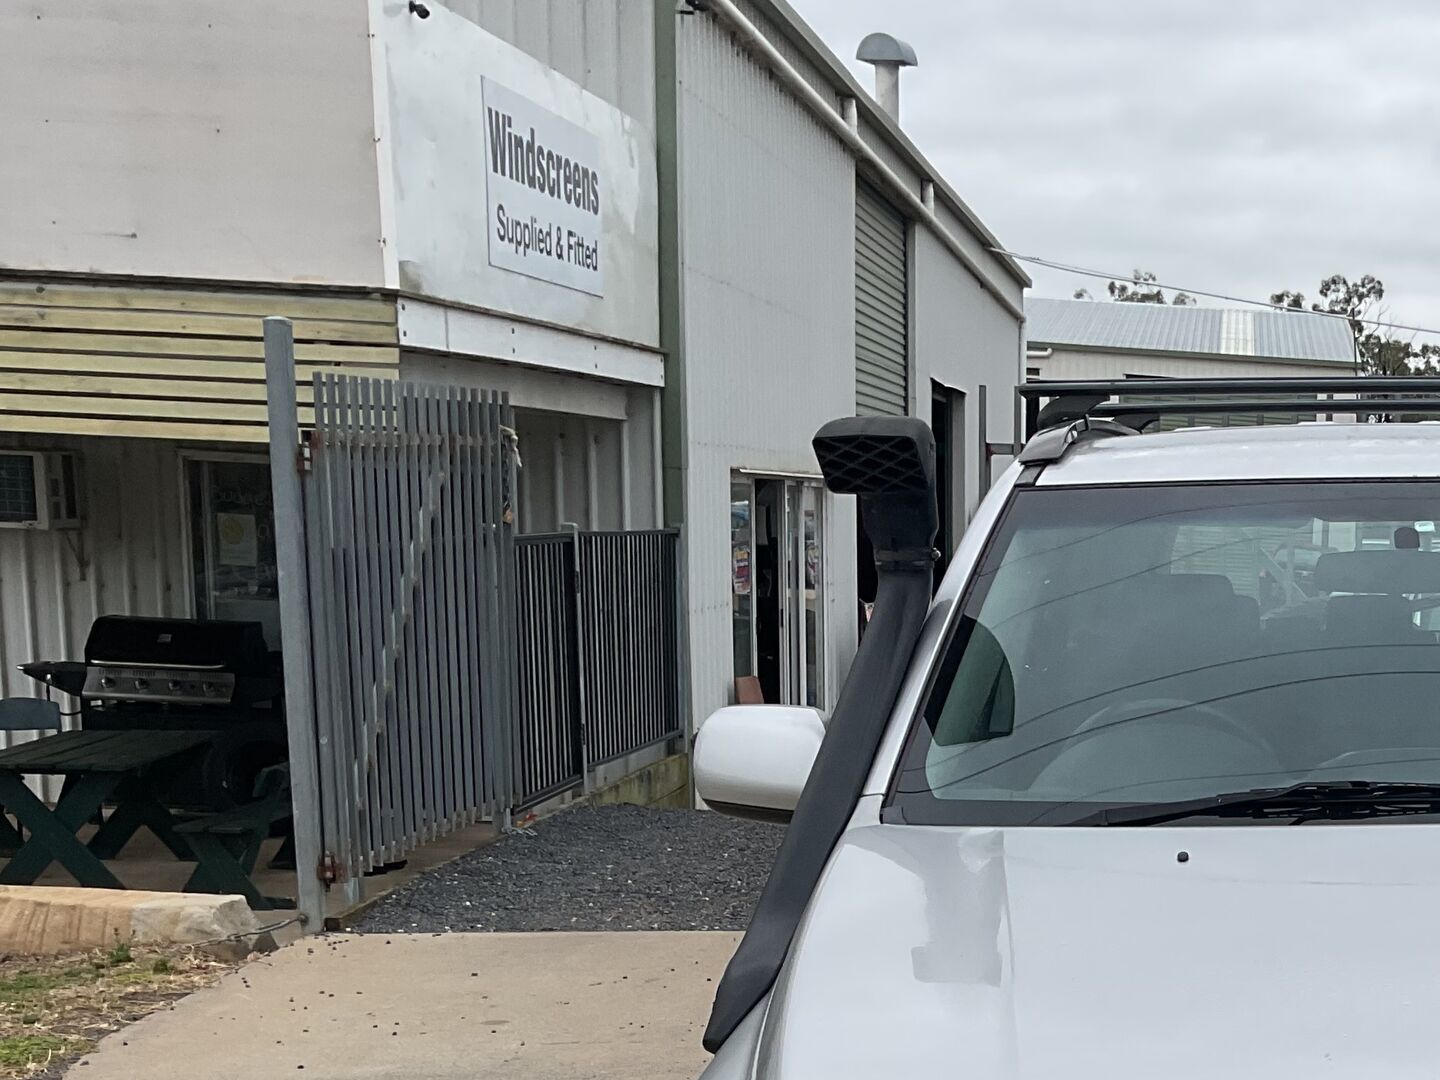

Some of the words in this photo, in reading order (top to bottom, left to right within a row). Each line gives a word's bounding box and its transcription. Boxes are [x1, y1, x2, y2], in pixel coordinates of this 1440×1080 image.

[487, 106, 599, 215] Windscreens
[496, 203, 552, 256] Supplied
[556, 226, 564, 260] &
[567, 229, 598, 271] Fitted
